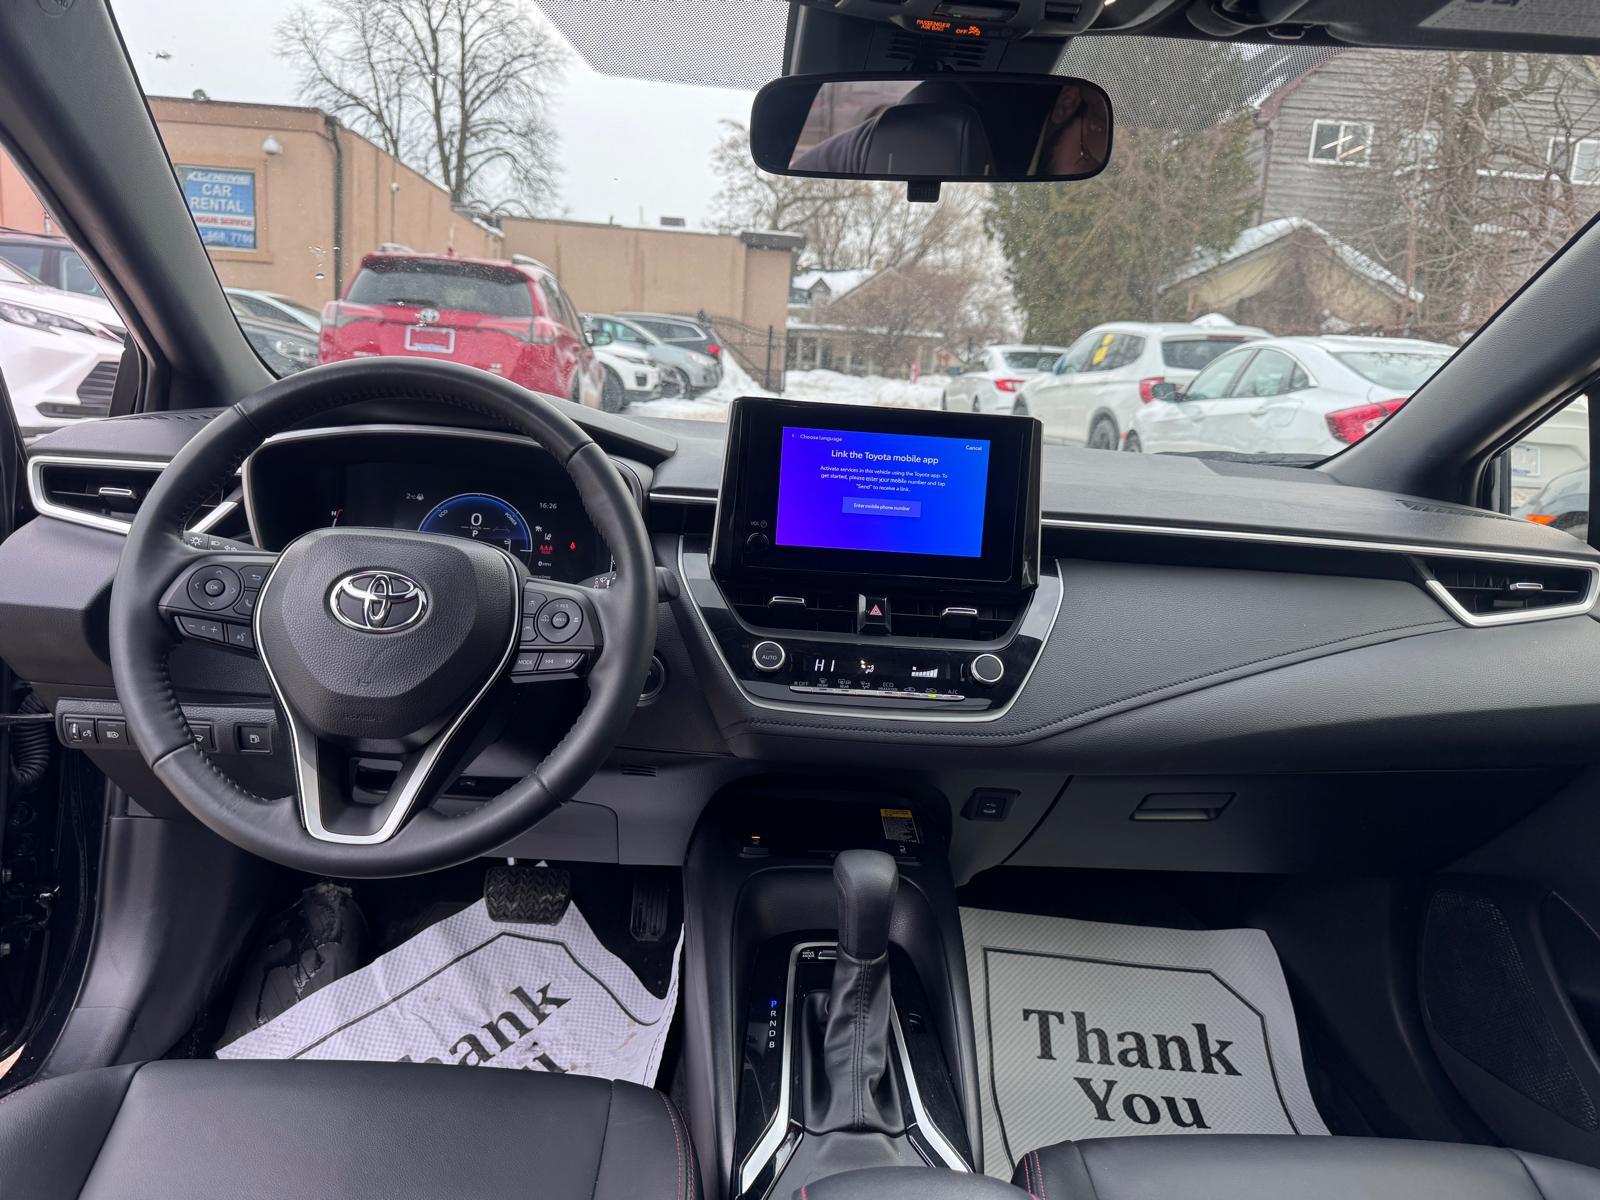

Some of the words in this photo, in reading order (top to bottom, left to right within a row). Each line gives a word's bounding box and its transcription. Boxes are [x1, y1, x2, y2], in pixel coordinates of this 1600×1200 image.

[916, 19, 951, 28] PASSENGER
[202, 183, 232, 198] CAR
[190, 196, 246, 212] RENTAL
[831, 450, 848, 458] Link
[865, 452, 891, 461] Toyota
[893, 454, 921, 463] mobile
[471, 513, 482, 526] 0
[504, 512, 517, 526] POWER
[814, 659, 835, 672] HI
[1022, 1008, 1243, 1076] Thank
[1073, 1076, 1212, 1129] You
